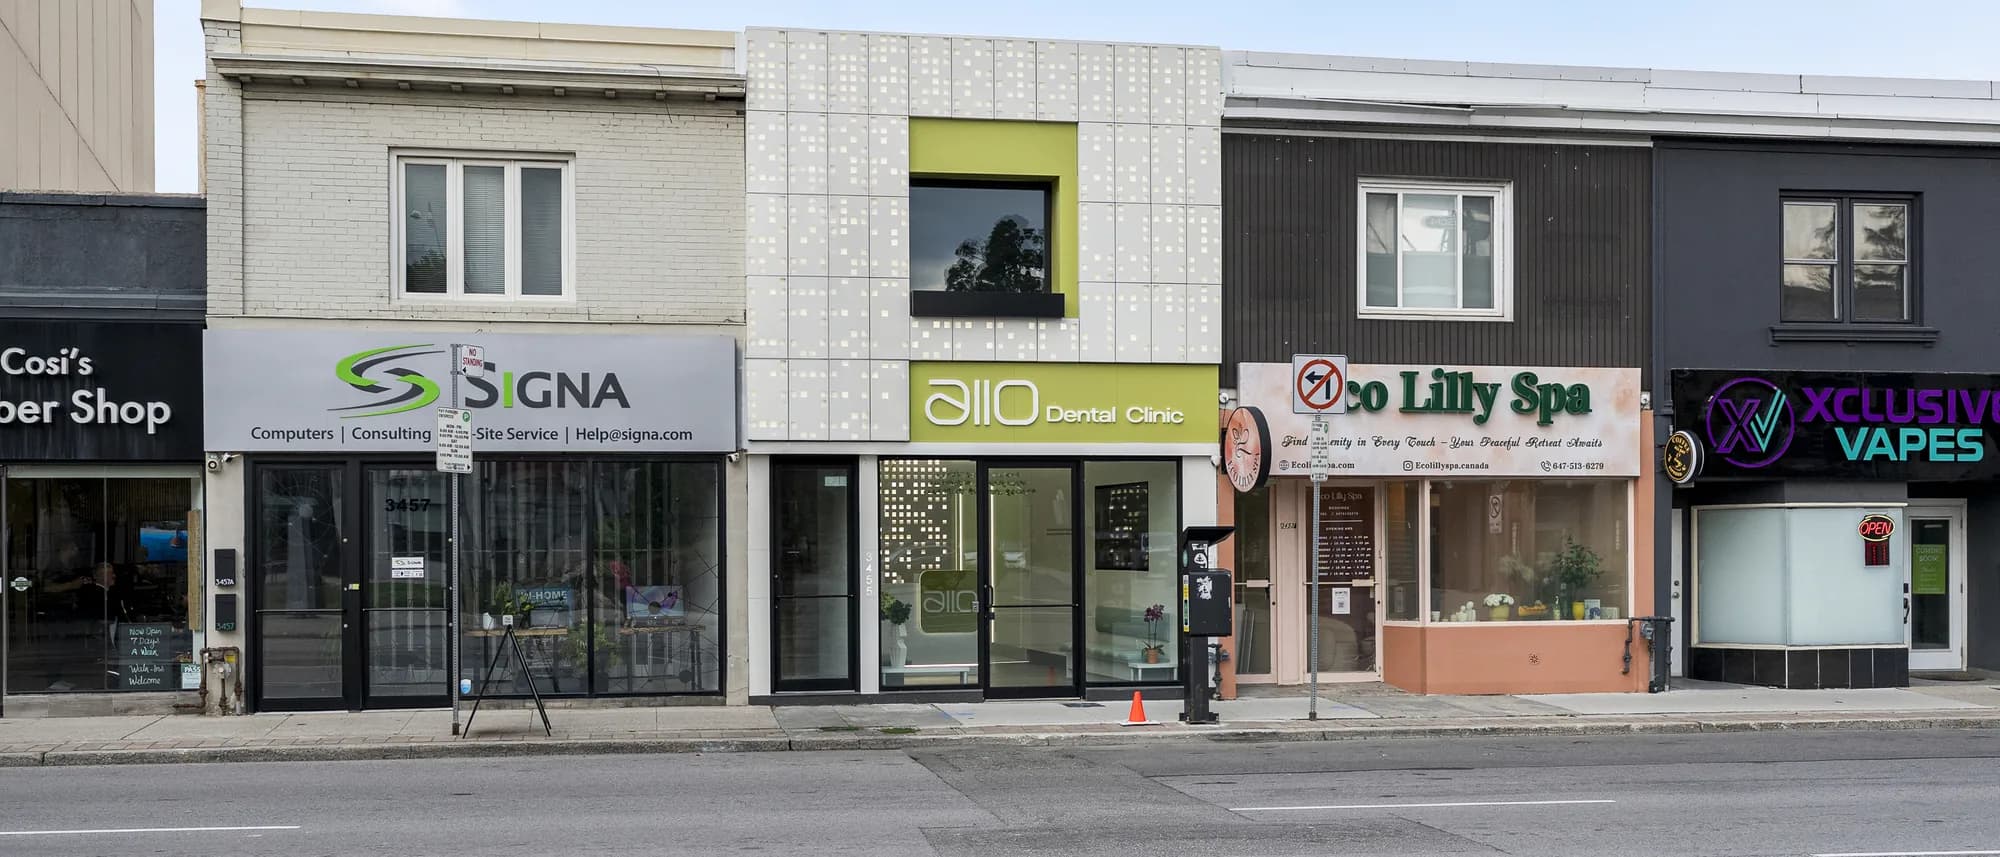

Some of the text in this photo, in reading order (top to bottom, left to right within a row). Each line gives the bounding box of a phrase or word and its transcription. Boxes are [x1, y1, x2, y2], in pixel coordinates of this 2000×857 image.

[469, 349, 476, 357] NO
[0, 347, 93, 375] Cosi's
[463, 357, 483, 368] STANDING
[465, 362, 632, 408] SIGNA
[1347, 367, 1593, 427] co Lilly Spa
[70, 387, 172, 434] Shop
[1801, 387, 2000, 424] XCLUSIV
[1046, 406, 1117, 423] Dental
[1126, 407, 1185, 424] Clinic
[251, 426, 334, 443] Computers
[351, 426, 432, 443] Consulting
[472, 427, 503, 440] -Site
[506, 427, 559, 440] Service
[576, 427, 693, 443] Help@signa.com
[1281, 435, 1308, 448] Find
[1328, 436, 1352, 450] enity
[1357, 436, 1367, 446] in
[1372, 436, 1400, 450] Every
[1405, 436, 1436, 448] Touch
[1449, 436, 1474, 449] Your
[1479, 436, 1521, 450] Peaceful
[1525, 437, 1562, 448] Retreat
[1566, 437, 1603, 448] Awaits
[1834, 427, 1984, 462] VAPES
[1415, 461, 1489, 471] Ecolillyspa.canada
[1552, 462, 1604, 471] 647-513-6279
[385, 498, 431, 512] 3457
[1860, 521, 1892, 535] OPEN
[146, 627, 162, 636] Open
[130, 637, 160, 648] 7 Days
[129, 675, 160, 685] Welcome
